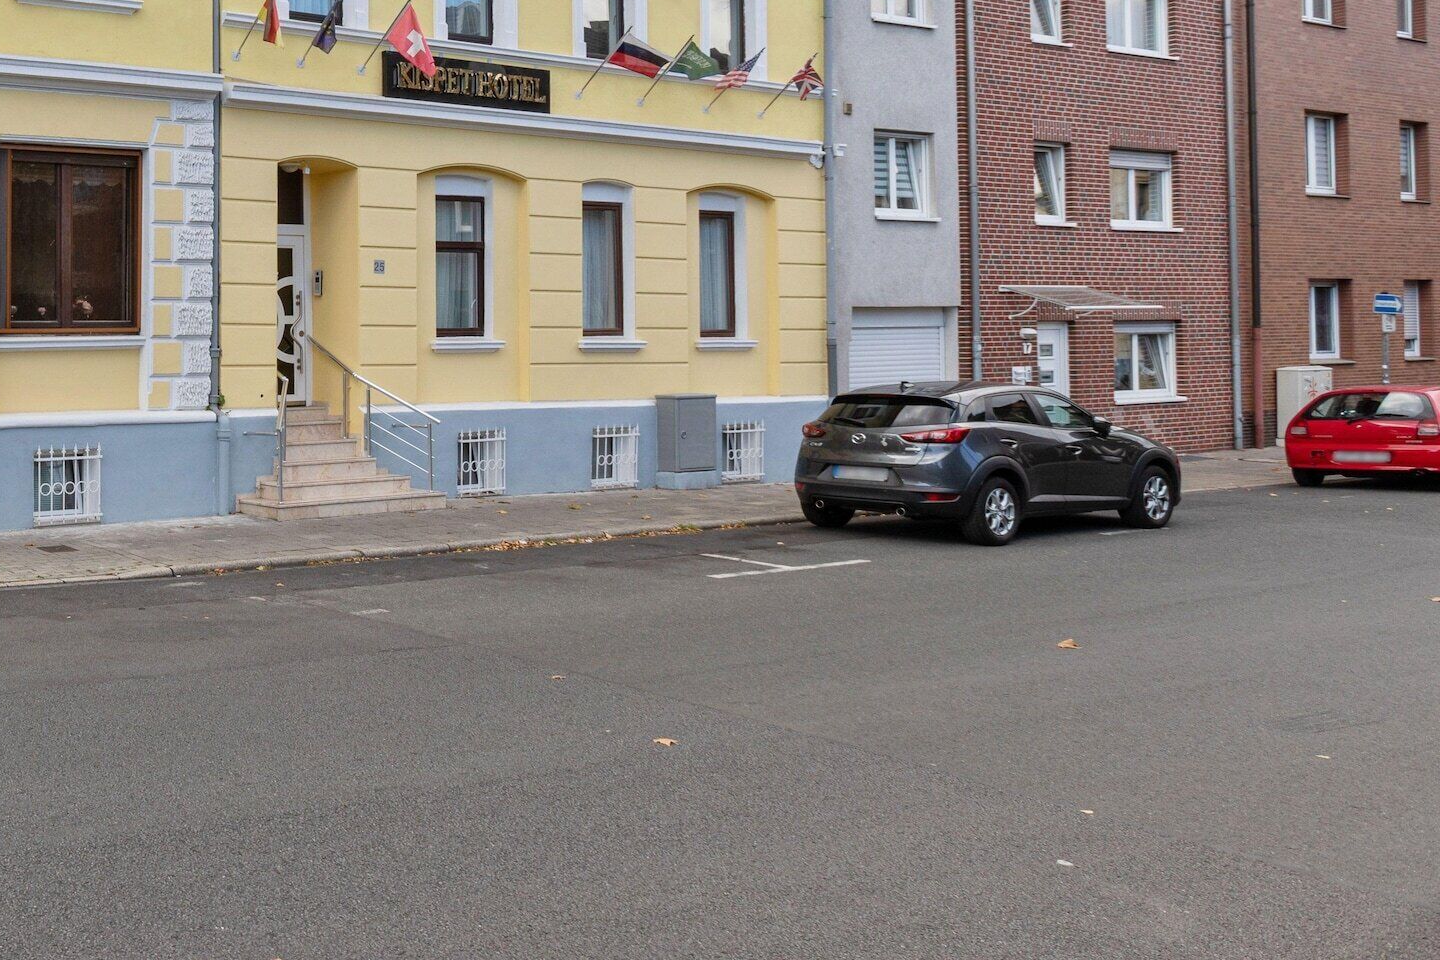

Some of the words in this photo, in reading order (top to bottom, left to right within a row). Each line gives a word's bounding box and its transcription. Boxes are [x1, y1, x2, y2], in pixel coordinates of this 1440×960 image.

[475, 71, 547, 104] HOTEL
[374, 261, 385, 272] 25
[1021, 342, 1033, 355] 17
